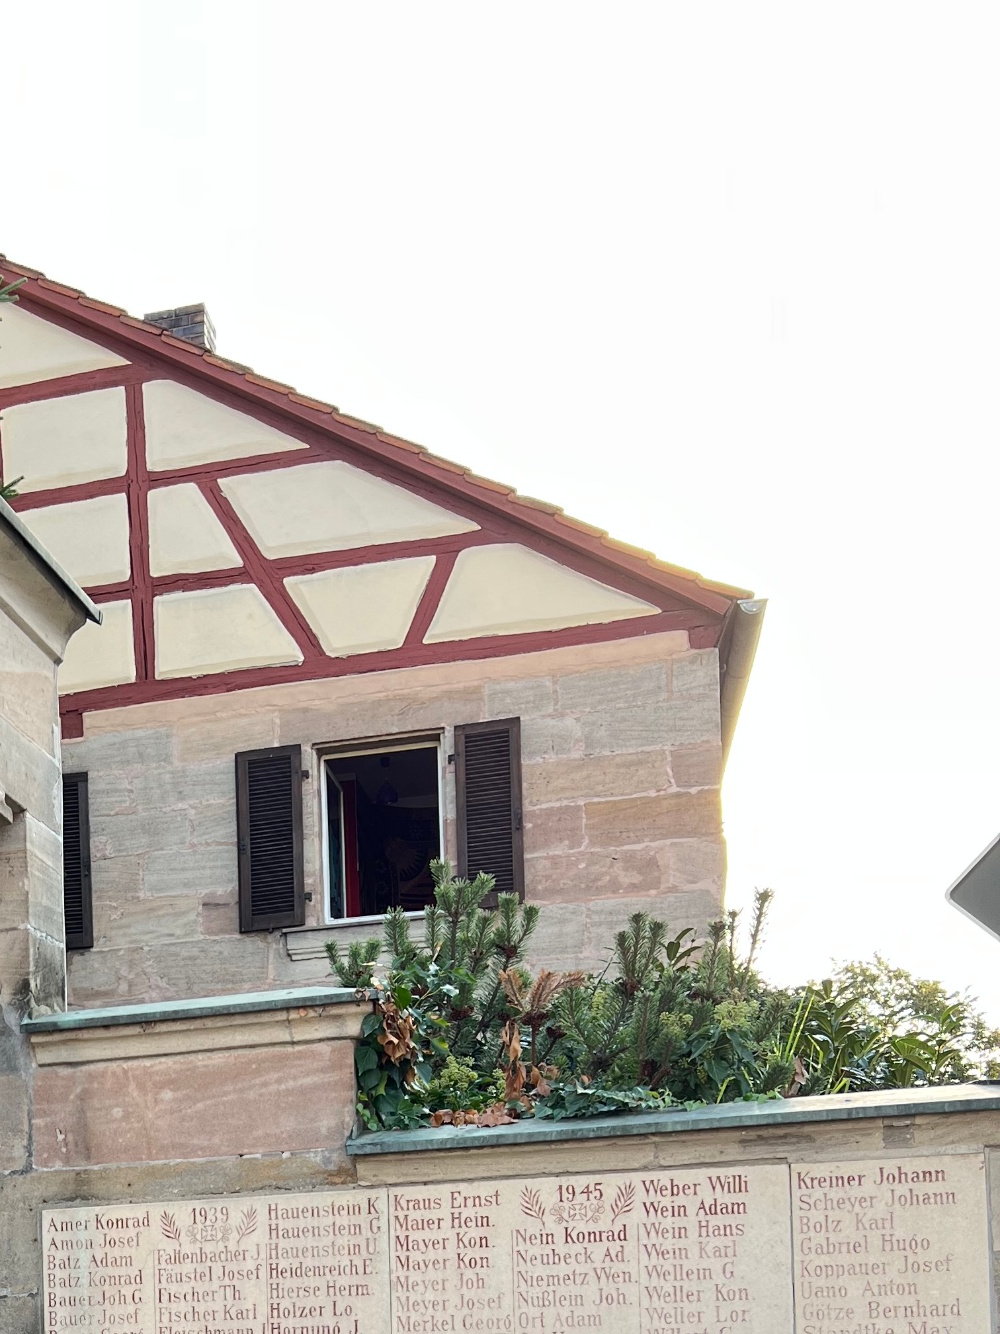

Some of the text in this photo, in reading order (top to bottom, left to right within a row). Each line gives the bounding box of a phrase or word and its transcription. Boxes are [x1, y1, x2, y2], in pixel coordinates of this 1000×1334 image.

[641, 1175, 749, 1198] Weber Willi
[797, 1167, 946, 1189] Kreiner Johann
[393, 1191, 502, 1212] Kraus Ernst
[557, 1183, 604, 1203] 1945
[799, 1189, 957, 1214] Scheyer Johann
[190, 1206, 229, 1227] 1939
[268, 1201, 361, 1221] Hauenstein
[642, 1199, 748, 1219] Wein Adam
[47, 1212, 150, 1233] Amer Konrad
[394, 1212, 496, 1232] Maier Hein.
[800, 1212, 894, 1234] Bolz Karl
[395, 1232, 496, 1253] Mayer Kon.
[515, 1225, 628, 1247] Nein Konrad
[800, 1234, 930, 1256] Gabriel Hugo
[47, 1251, 132, 1271] Batz Adam
[516, 1247, 631, 1266] Neubeck Ad.
[157, 1265, 263, 1285] Fäustel Josef
[269, 1261, 360, 1279] Heidenreich
[158, 1287, 218, 1304] Fischer
[518, 1288, 633, 1309] Nüßlein Joh.
[645, 1286, 705, 1304] Weller
[159, 1304, 257, 1323] Fischer Karl
[270, 1301, 325, 1319] Holzer
[803, 1298, 961, 1321] Götze Bernhard
[397, 1315, 512, 1333] Merkel Georg
